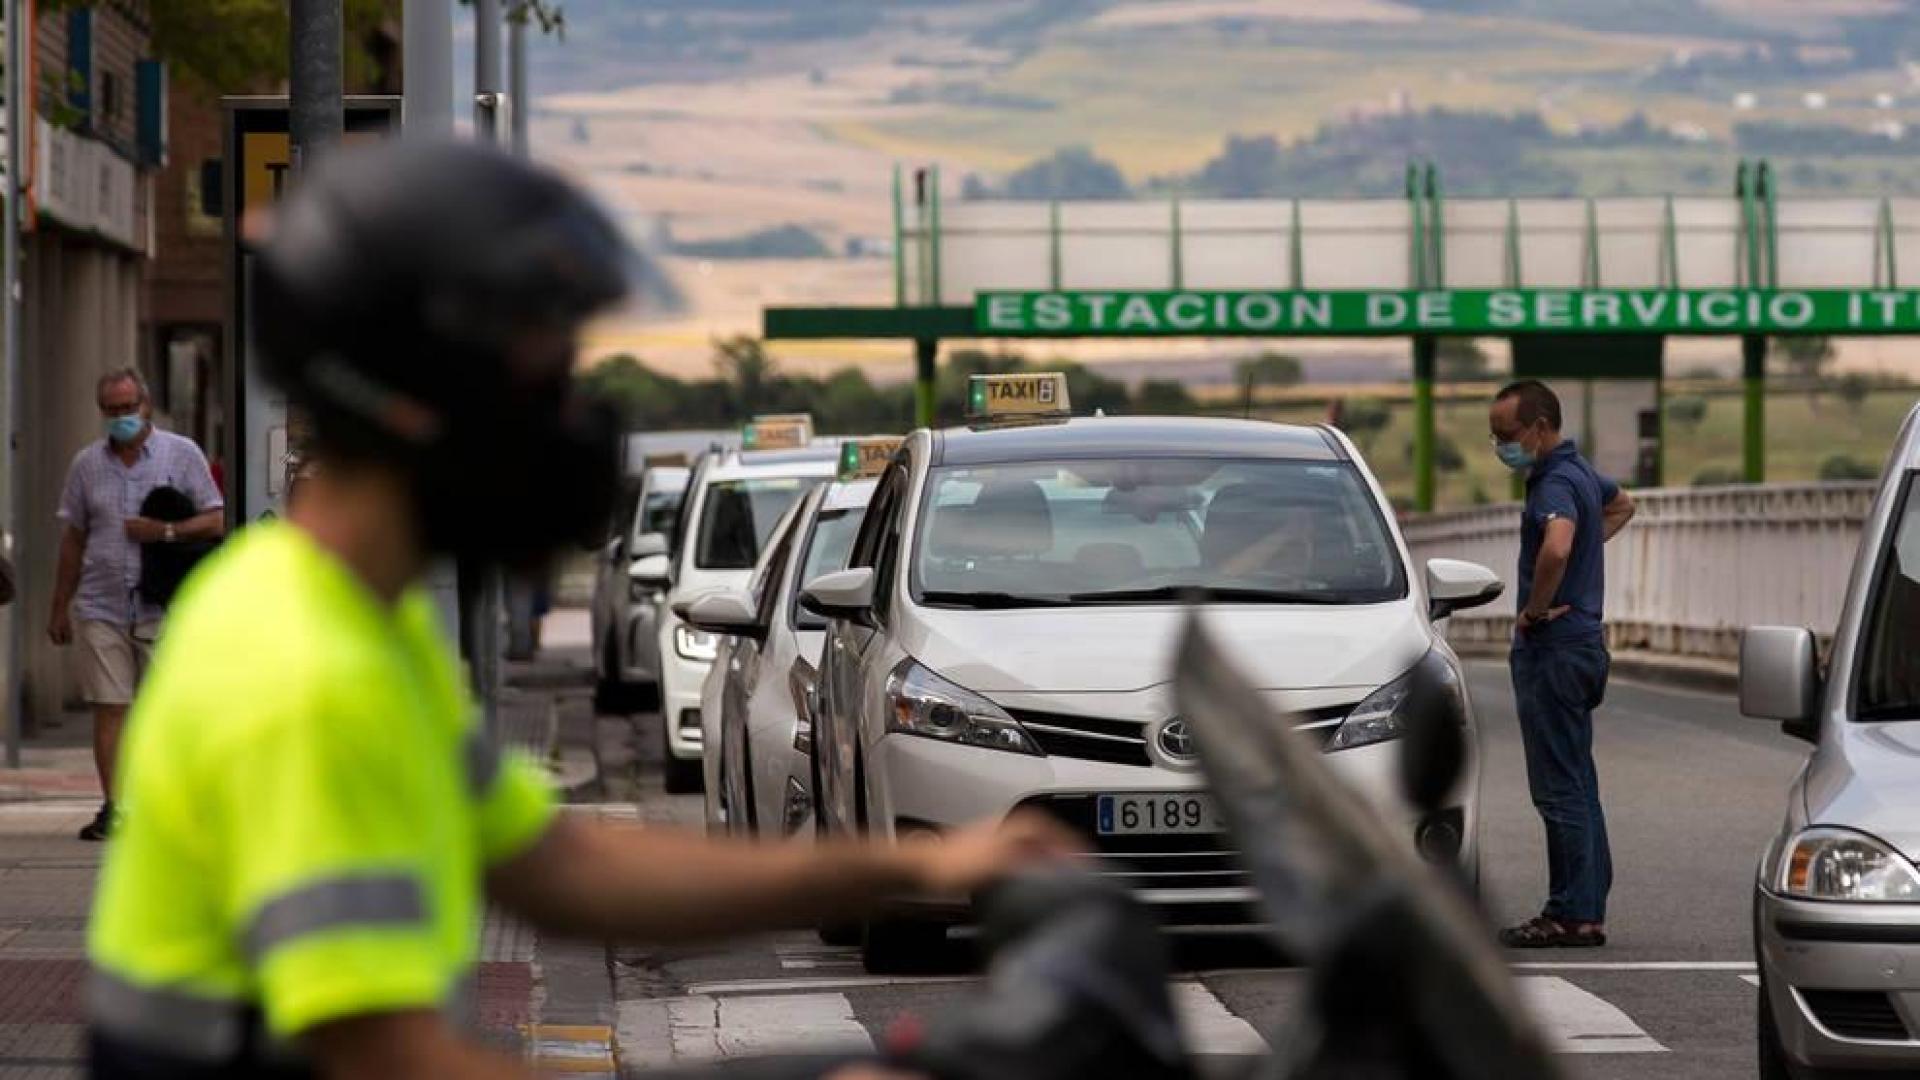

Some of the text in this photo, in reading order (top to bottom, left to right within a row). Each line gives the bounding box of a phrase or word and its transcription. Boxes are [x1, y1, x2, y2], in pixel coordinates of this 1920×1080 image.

[987, 292, 1920, 329] ESTACION DE SERVICIO IT
[987, 380, 1035, 400] TAXI
[862, 443, 900, 462] TAX
[1121, 799, 1201, 829] 6189
